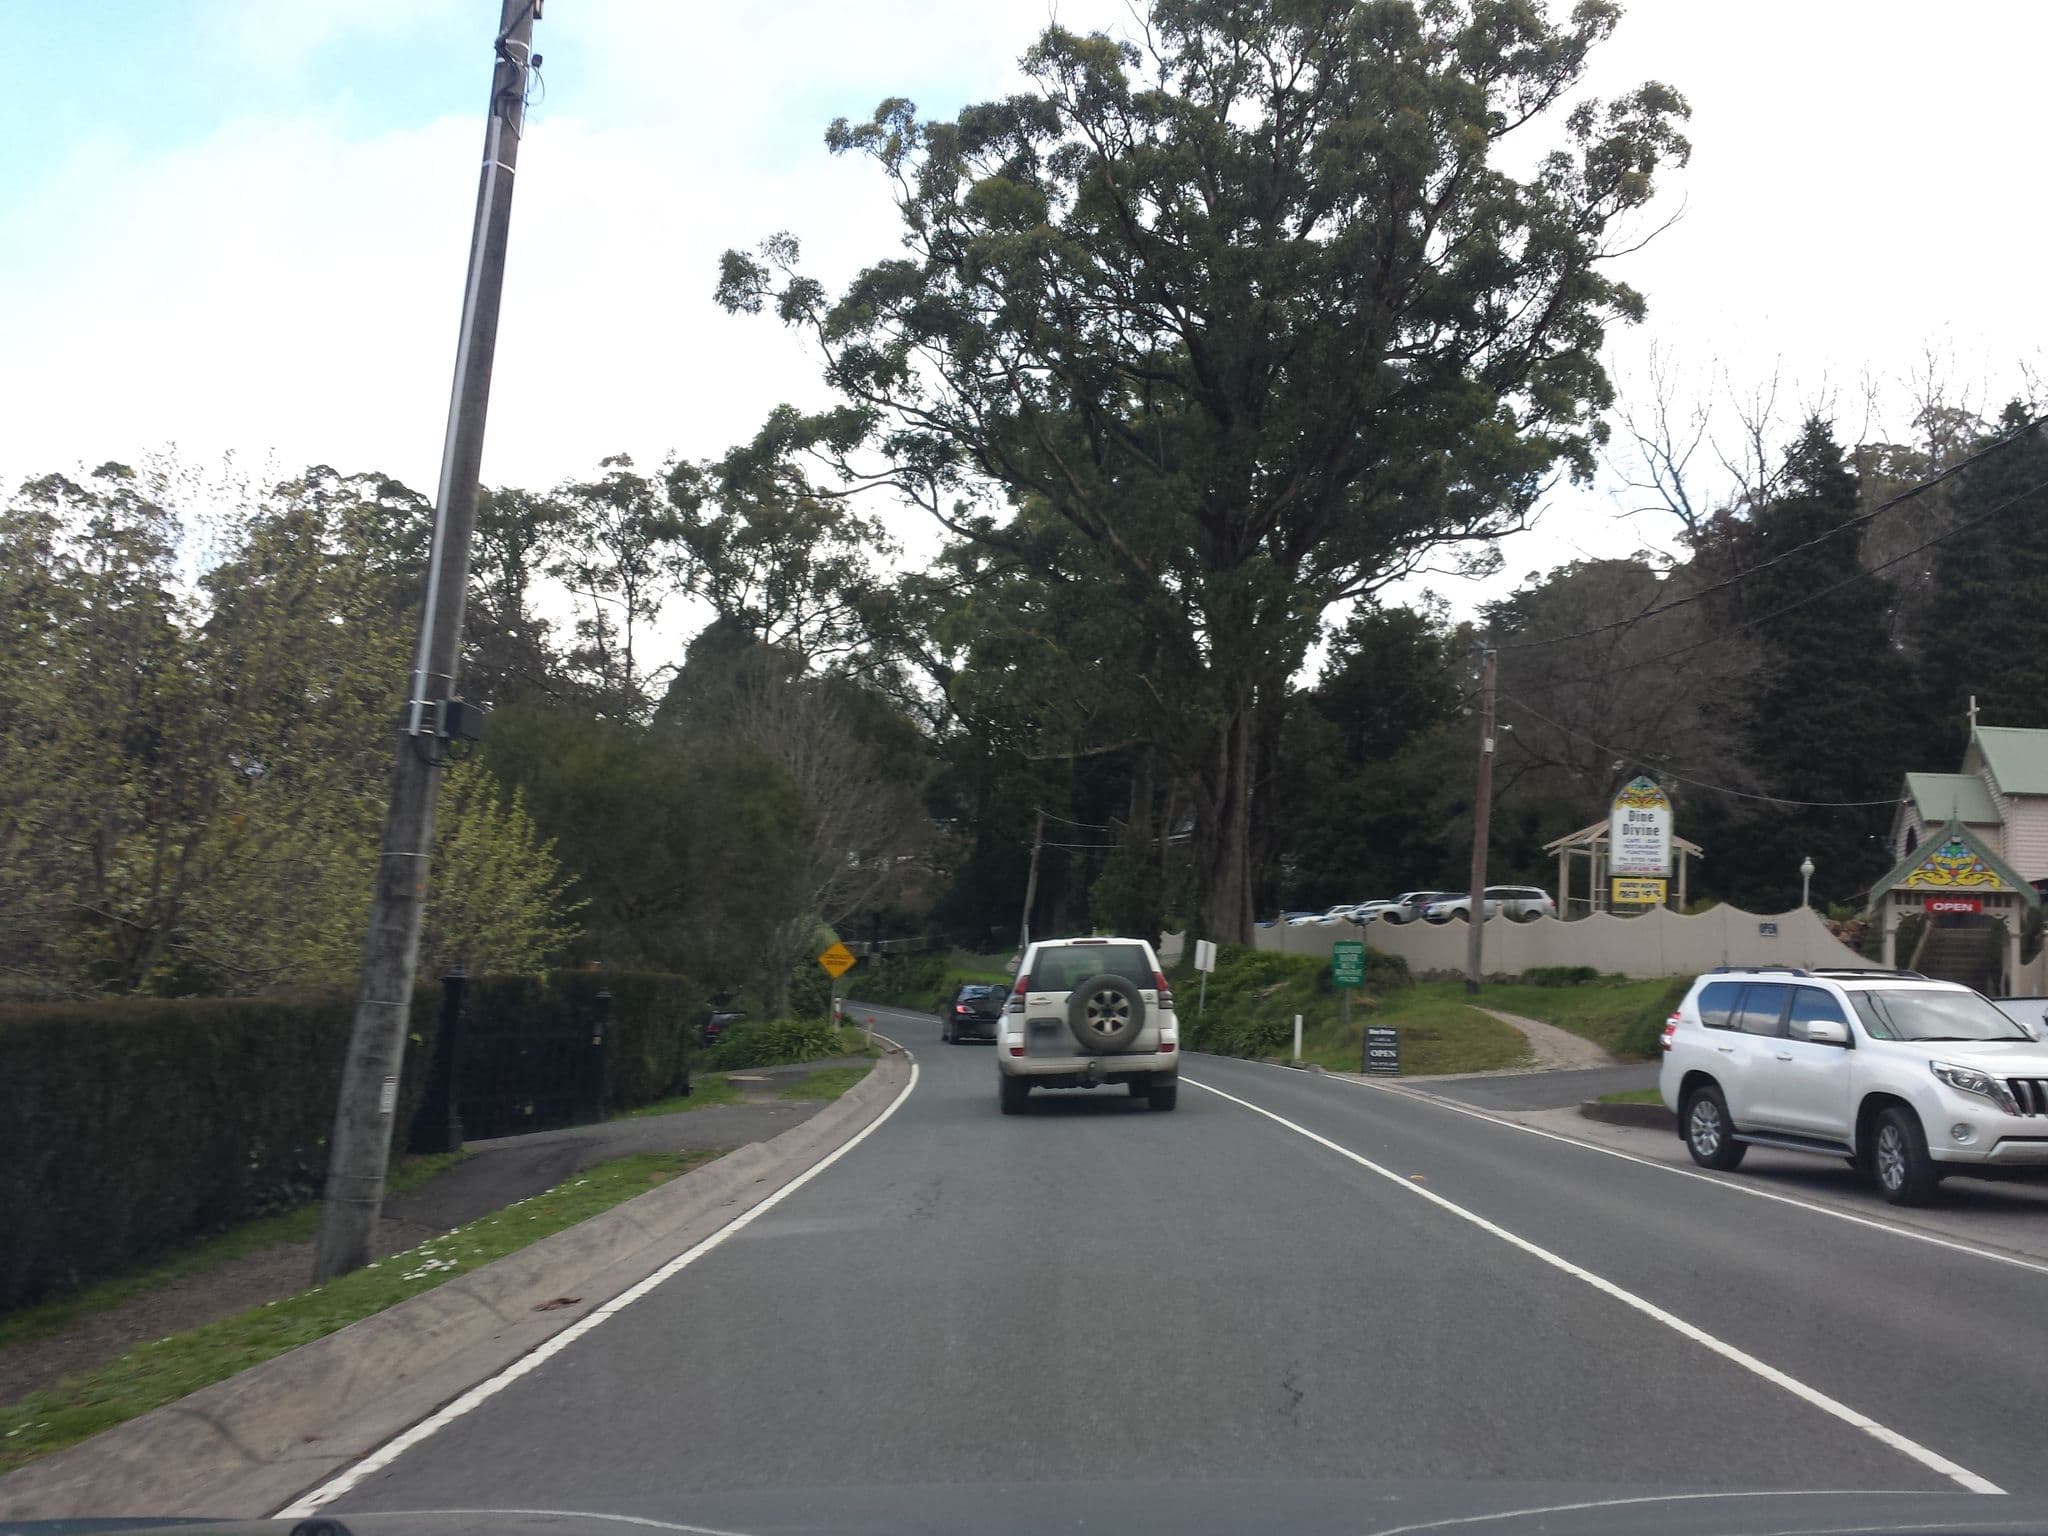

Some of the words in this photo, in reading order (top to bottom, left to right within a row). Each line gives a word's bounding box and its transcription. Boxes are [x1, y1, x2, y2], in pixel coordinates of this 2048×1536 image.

[1628, 809, 1655, 822] Dine
[1622, 823, 1660, 836] Divine
[1932, 902, 1974, 912] OPEN
[1370, 1049, 1397, 1057] OPEN
